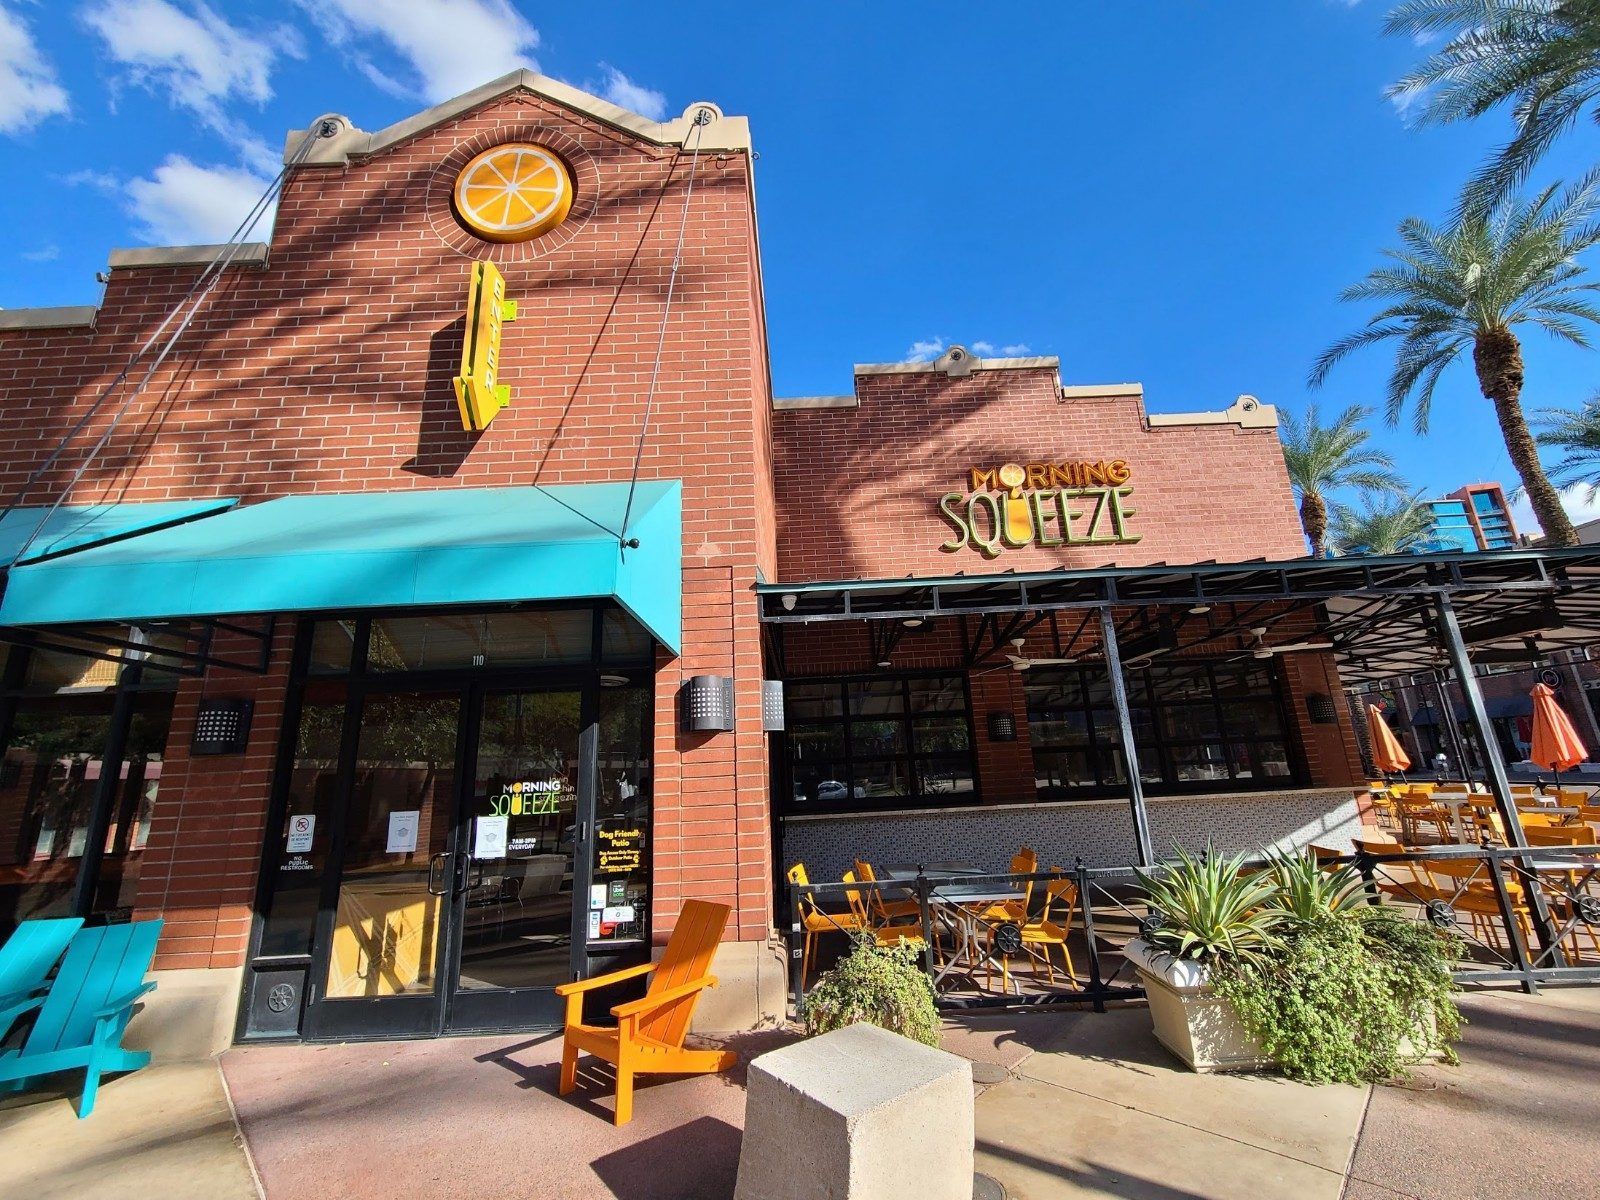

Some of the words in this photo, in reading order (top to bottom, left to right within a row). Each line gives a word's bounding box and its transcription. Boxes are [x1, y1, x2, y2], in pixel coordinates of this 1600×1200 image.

[971, 460, 1131, 489] MORNING
[940, 487, 1143, 556] SQUEEZE
[473, 655, 484, 666] 110
[503, 781, 561, 793] MORNING
[489, 792, 560, 817] SQUEEZE
[599, 831, 613, 839] Dog
[509, 843, 535, 851] EVERYDAY
[612, 839, 630, 847] Patio
